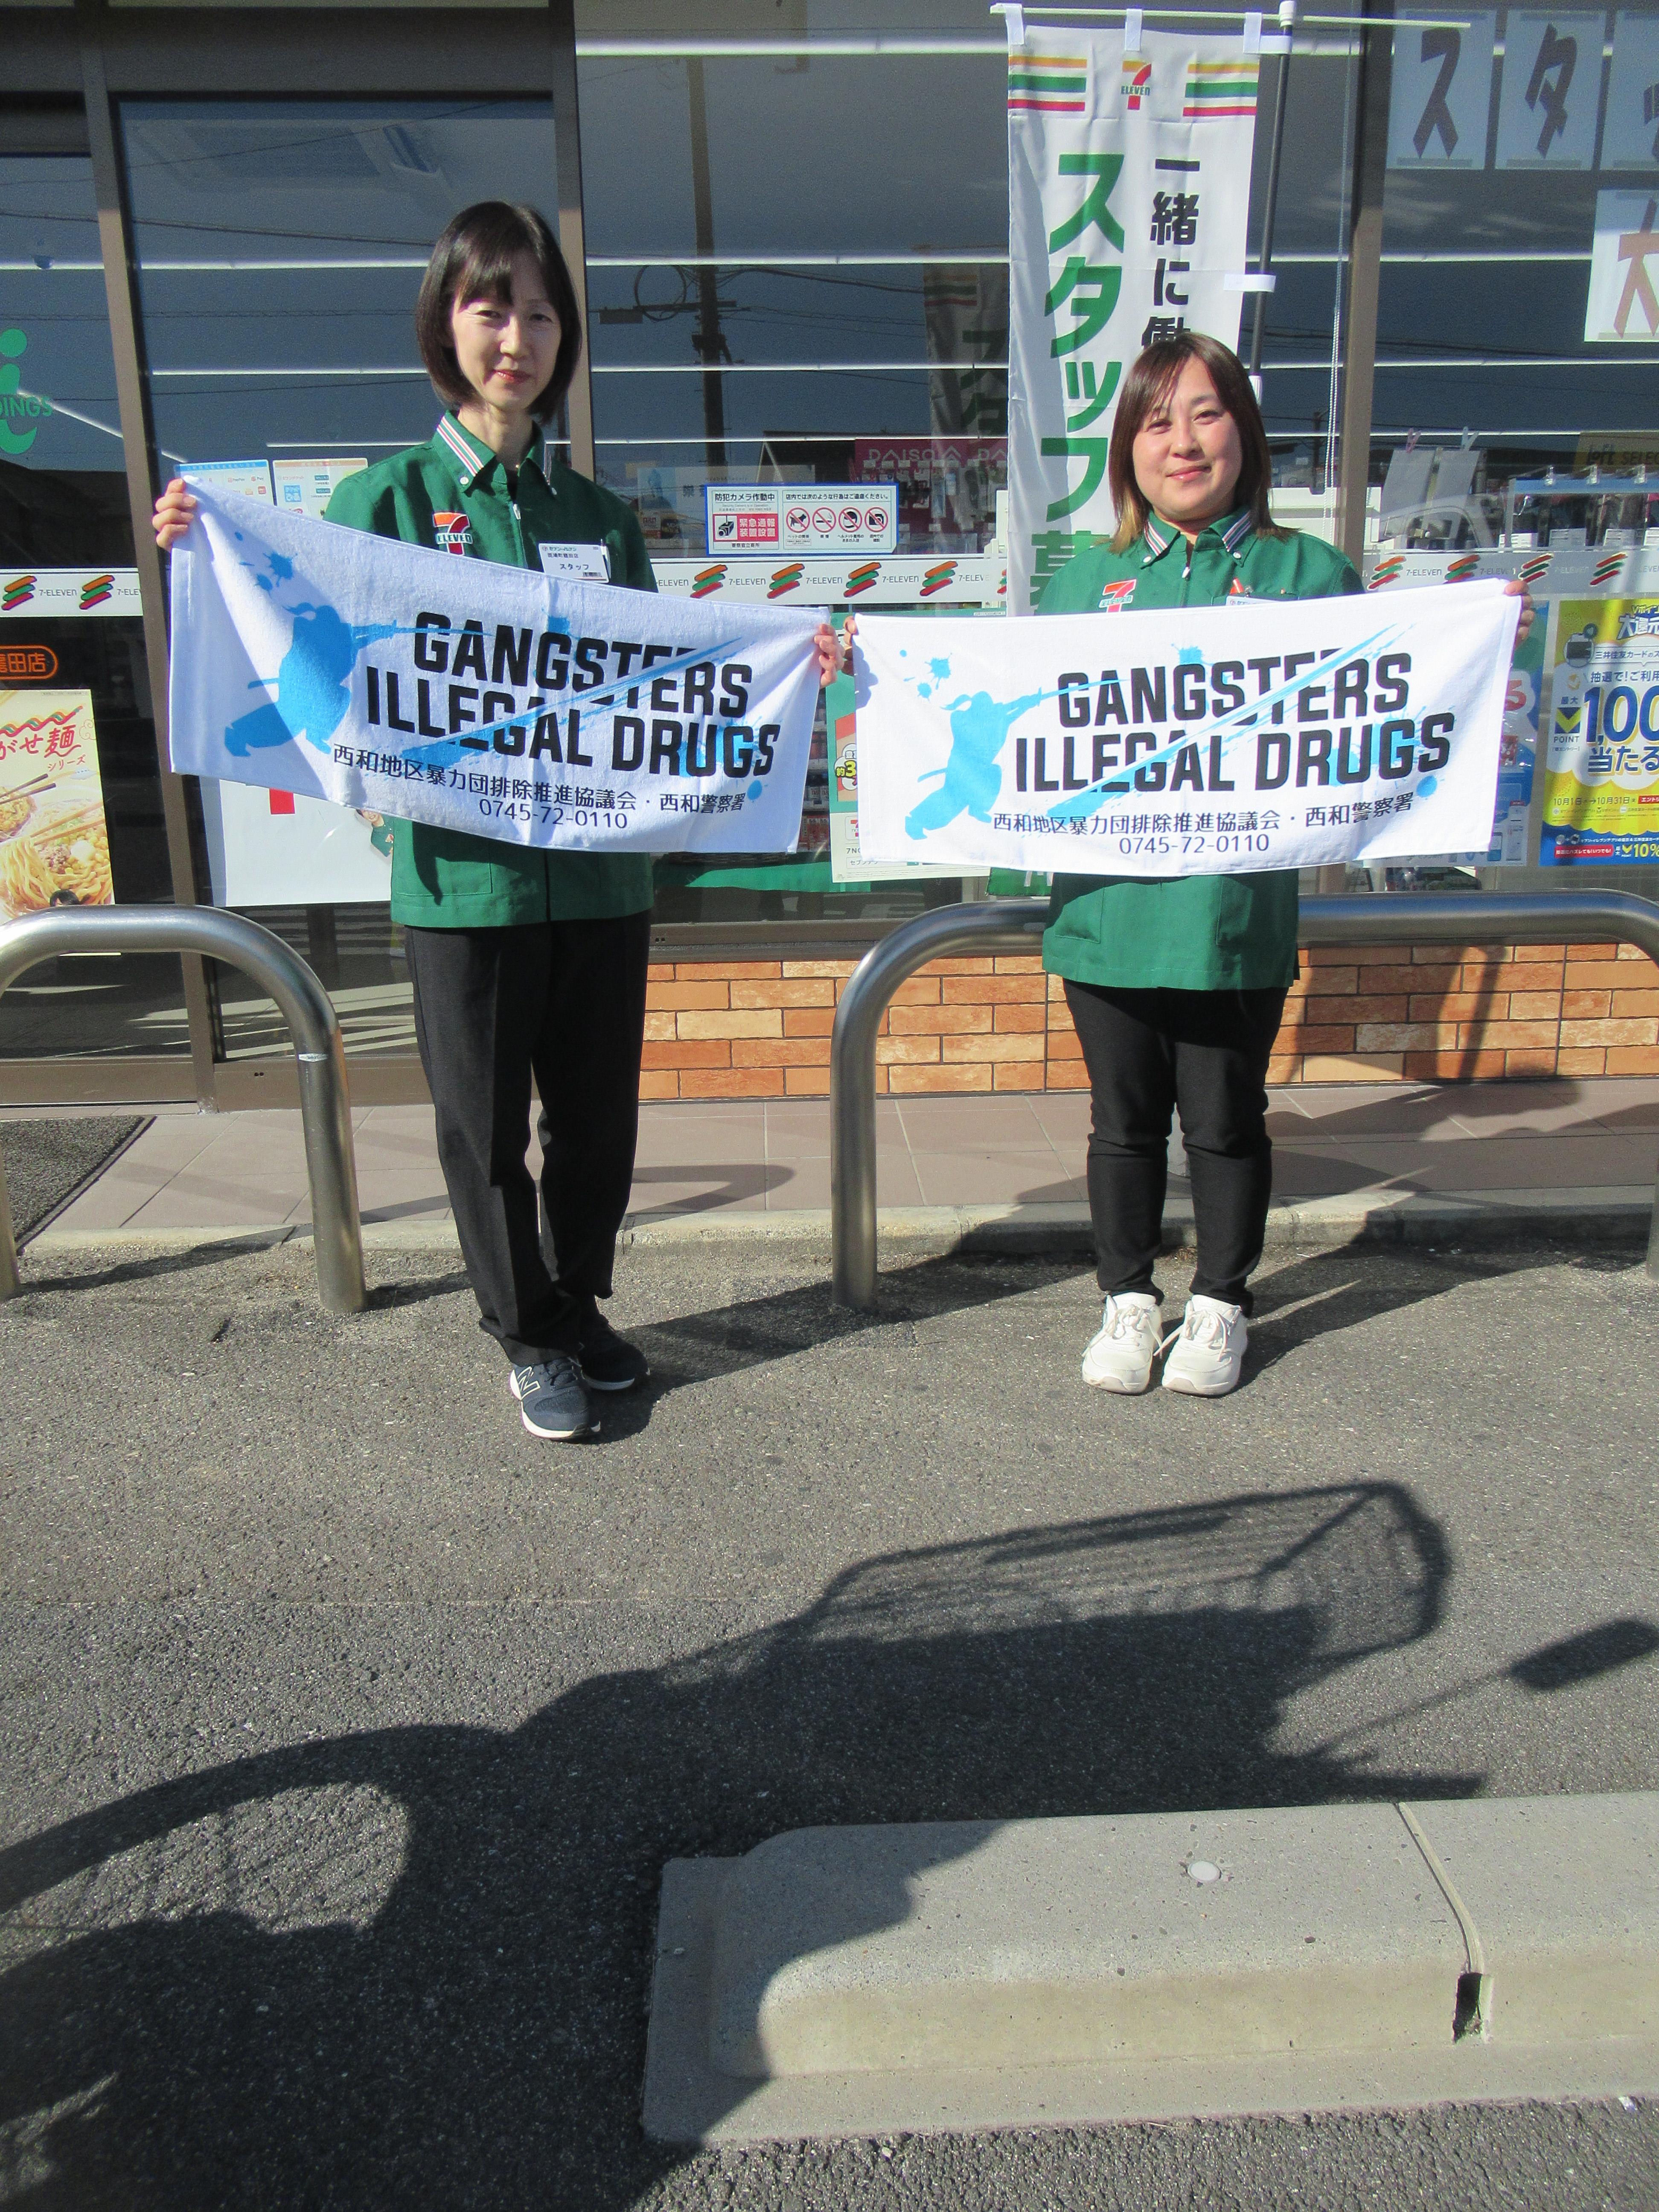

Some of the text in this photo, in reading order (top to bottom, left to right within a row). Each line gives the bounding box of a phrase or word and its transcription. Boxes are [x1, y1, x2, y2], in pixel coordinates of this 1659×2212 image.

[715, 493, 775, 501] 防犯カメラ作動中
[739, 518, 775, 527] 緊急通報
[740, 528, 776, 537] 装置設置
[414, 612, 752, 718] GANGSTERS
[1058, 648, 1412, 728] GANGSTERS
[367, 666, 781, 778] ILLEGAL DRUGS
[48, 754, 86, 771] シリーズ
[1016, 712, 1455, 792] ILLEGAL DRUGS
[1588, 745, 1659, 772] 当たる
[334, 744, 746, 814] 西和地区暴力団排除推進協議会・西和警察署
[479, 798, 627, 829] 0745-72-0110
[994, 792, 1414, 835] 西和地区暴力団排除推進協議会・西和警察署
[1119, 834, 1269, 854] 0745-72-0110
